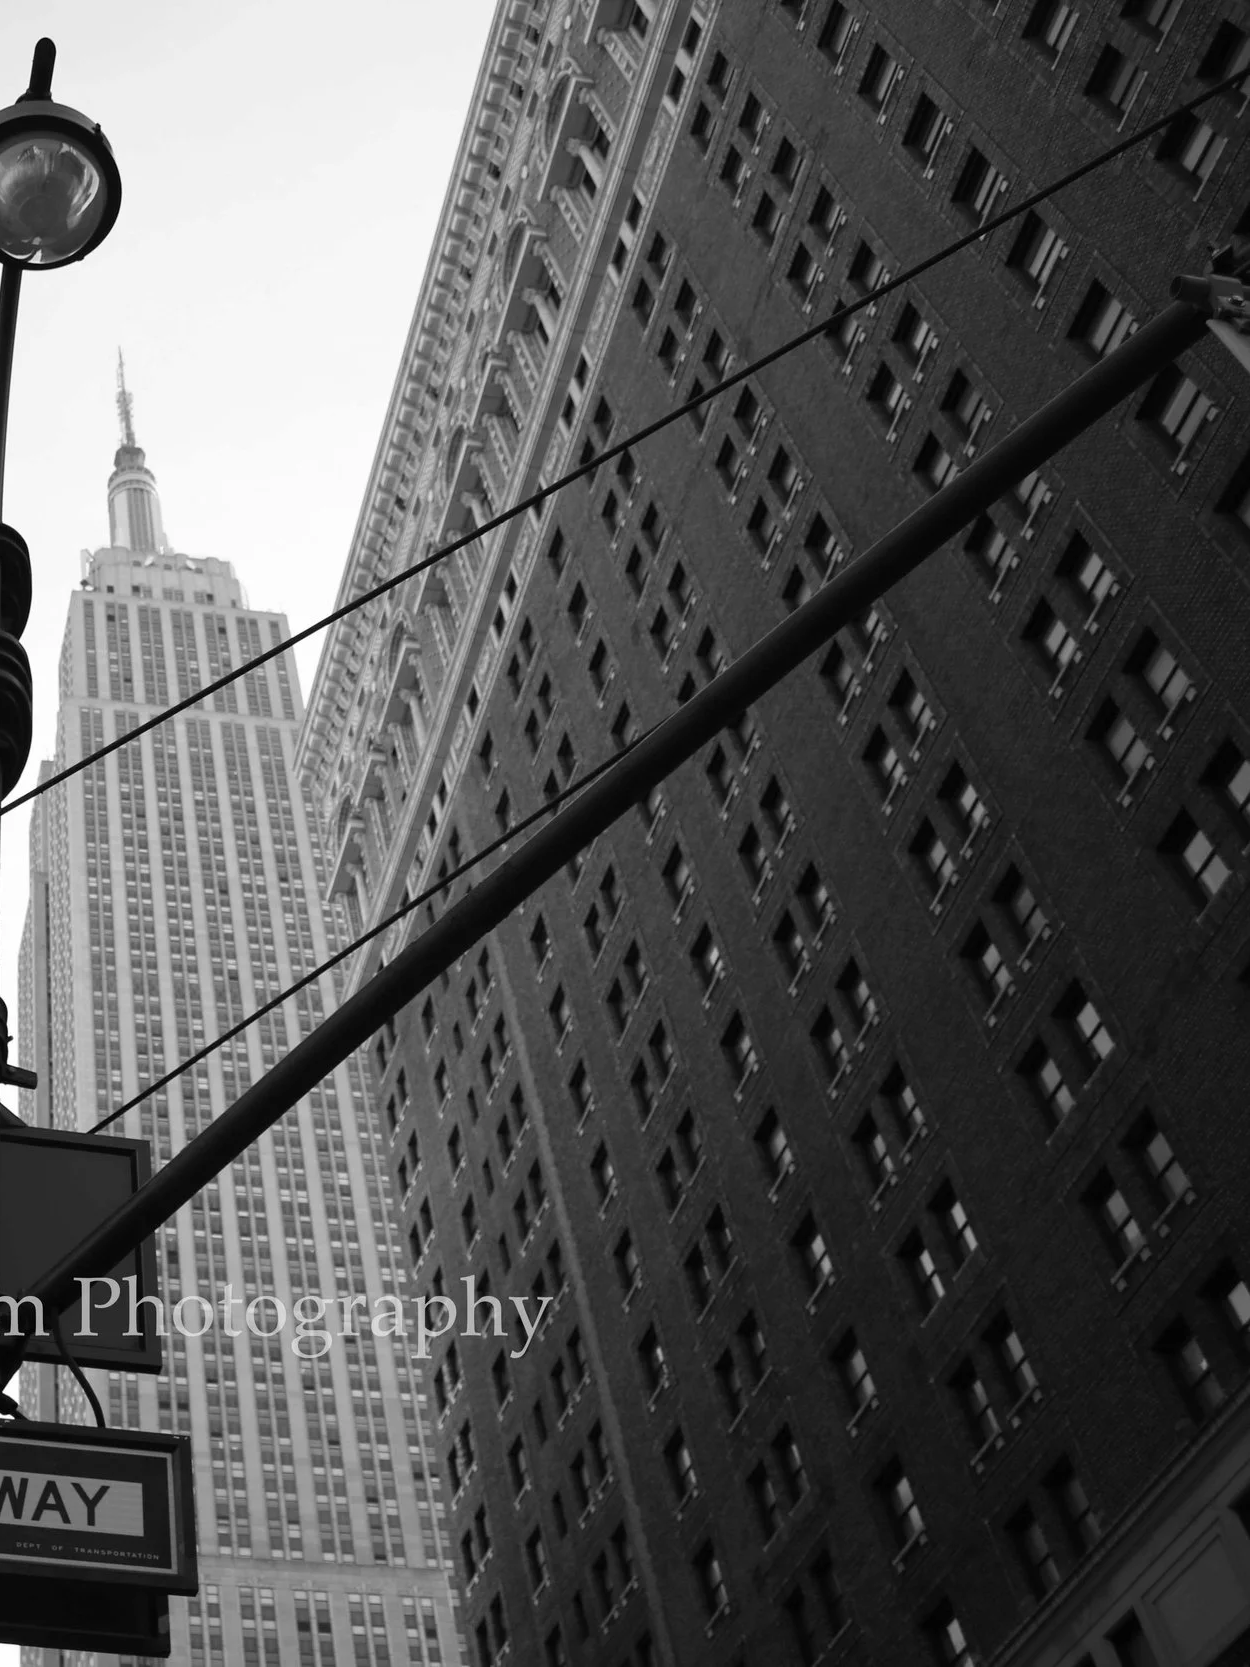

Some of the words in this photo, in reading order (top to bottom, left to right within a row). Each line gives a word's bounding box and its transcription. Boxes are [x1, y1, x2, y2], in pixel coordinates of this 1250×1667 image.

[15, 1541, 42, 1550] DEPT
[51, 1544, 64, 1552] OF
[74, 1546, 160, 1560] TRANSPORTATION
